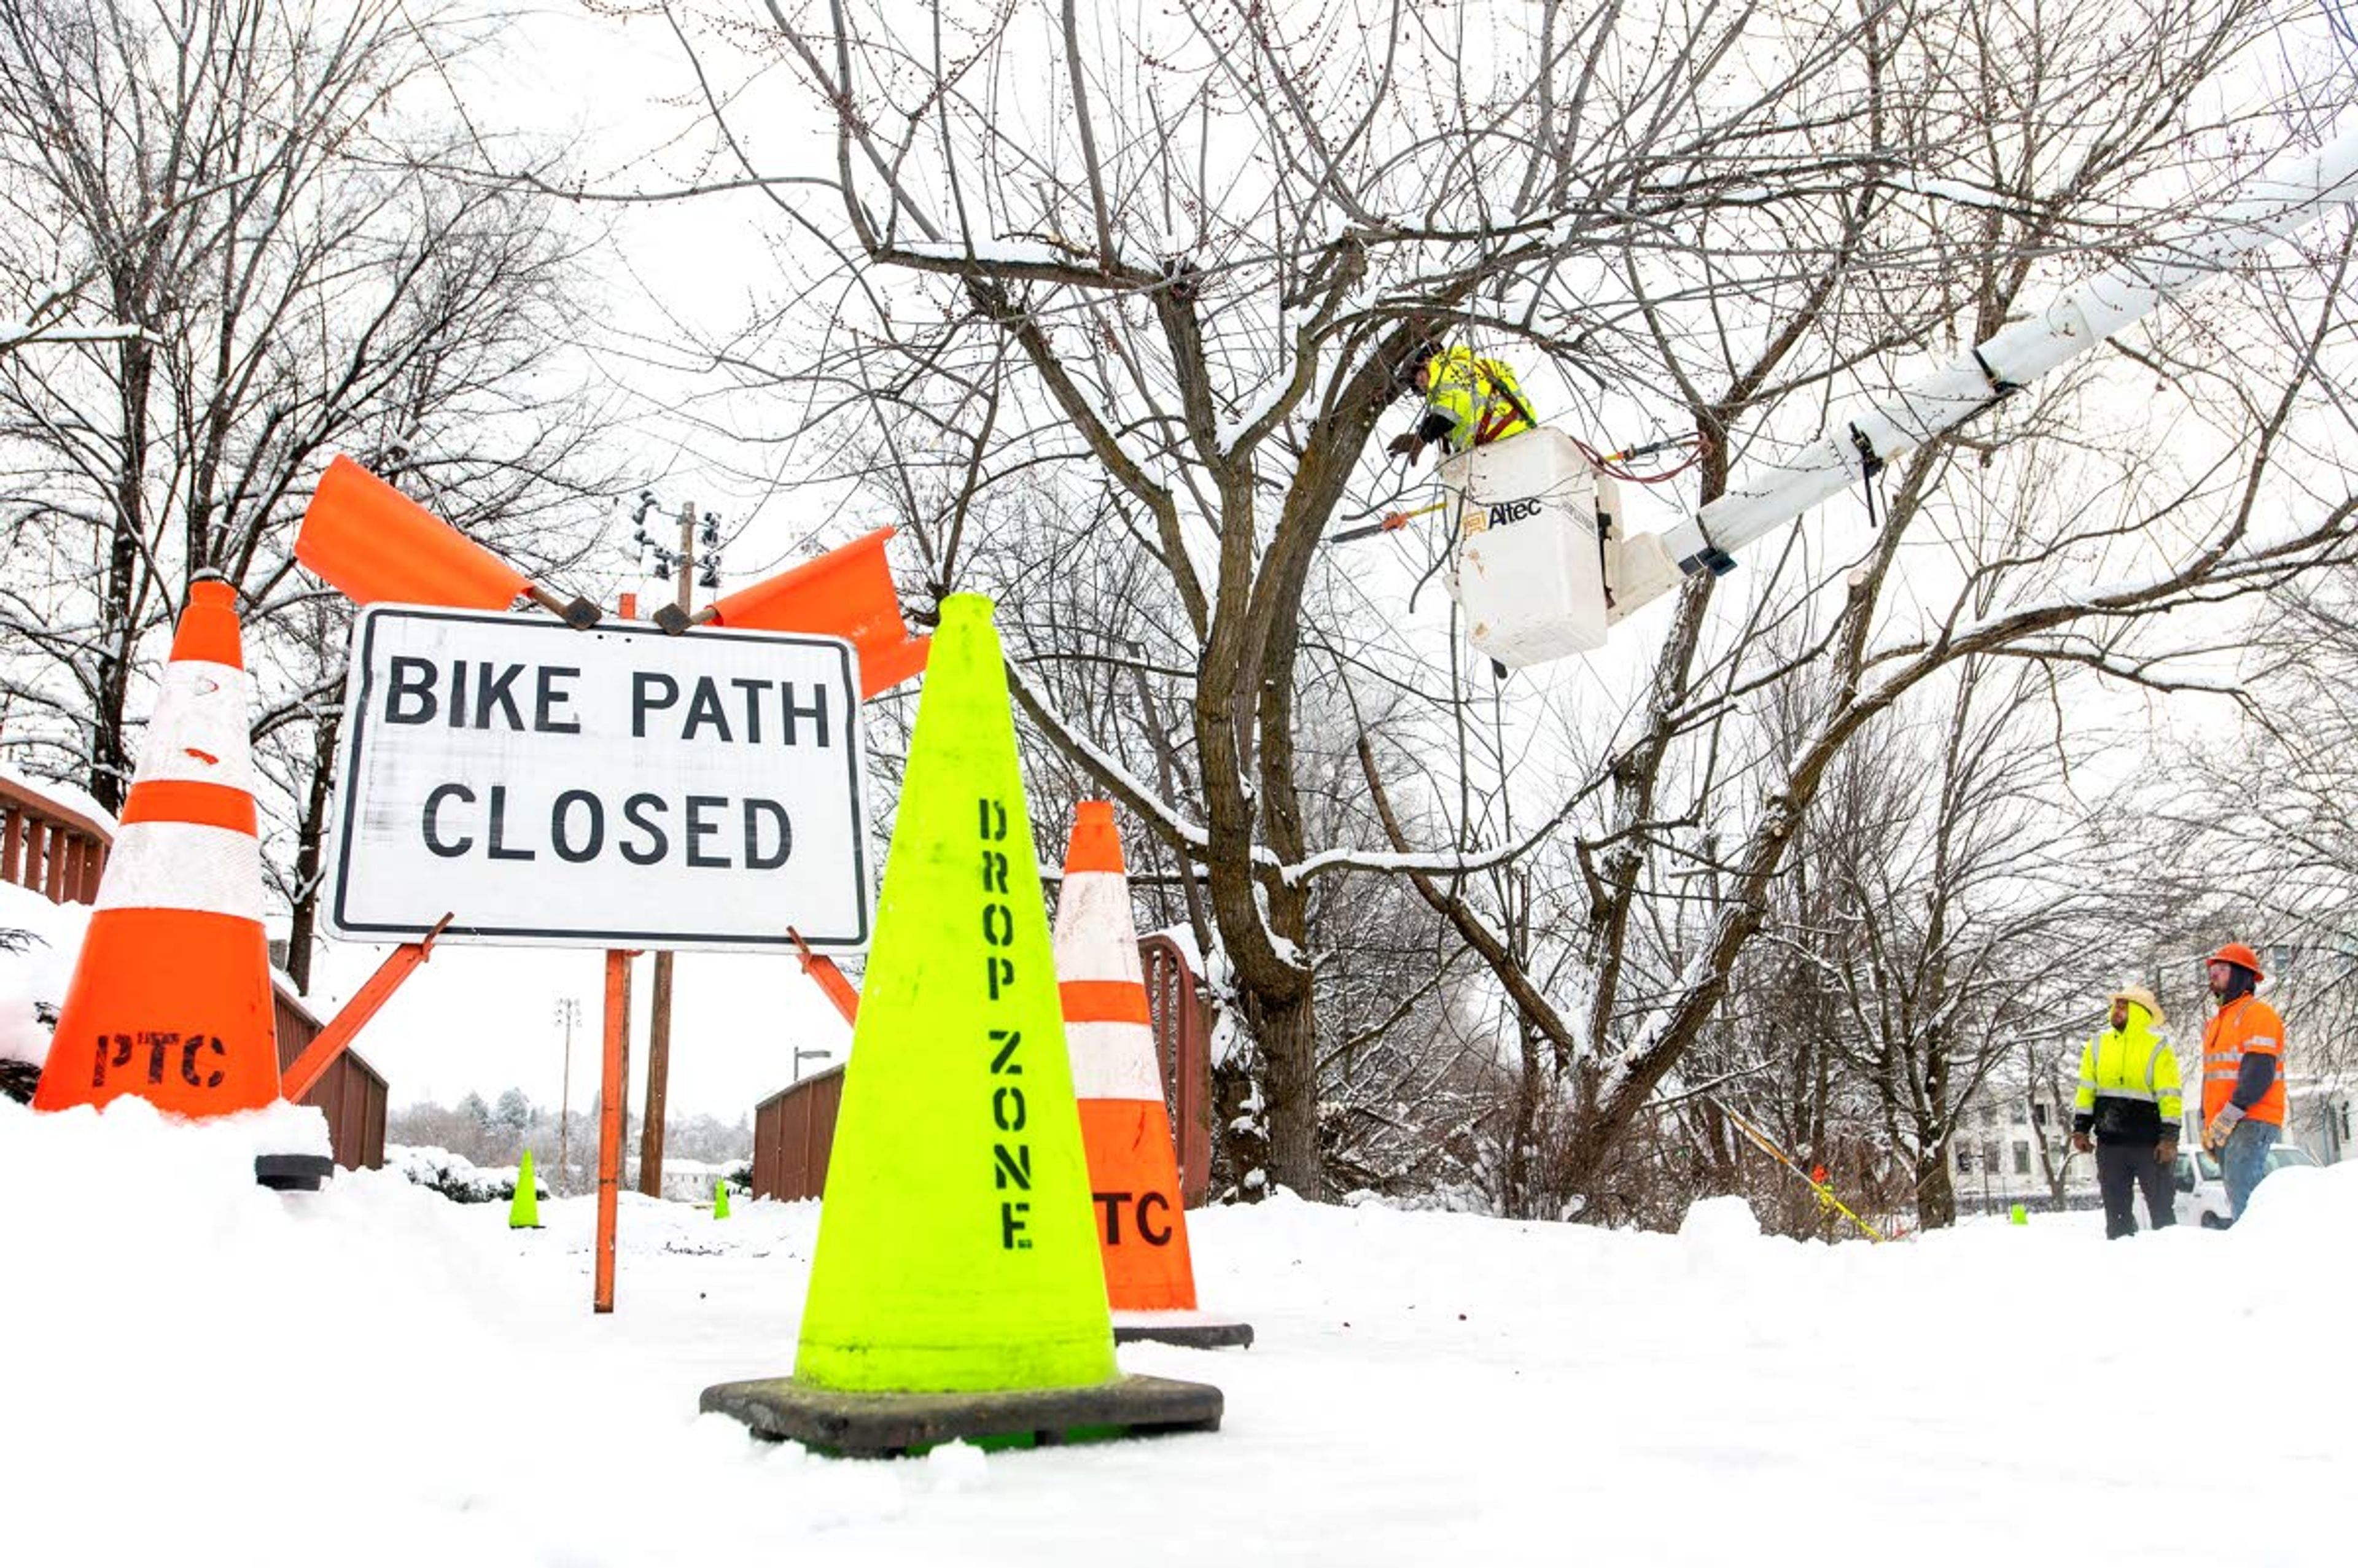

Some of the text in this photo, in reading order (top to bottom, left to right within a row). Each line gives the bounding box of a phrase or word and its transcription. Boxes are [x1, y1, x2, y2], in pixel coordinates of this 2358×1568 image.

[1488, 498, 1541, 529] Altec
[384, 656, 830, 747] BIKE PATH
[422, 783, 792, 869] CLOSED
[93, 1031, 225, 1087] PTC
[978, 798, 1033, 1249] DROP ZONE
[1092, 1192, 1172, 1246] TC
